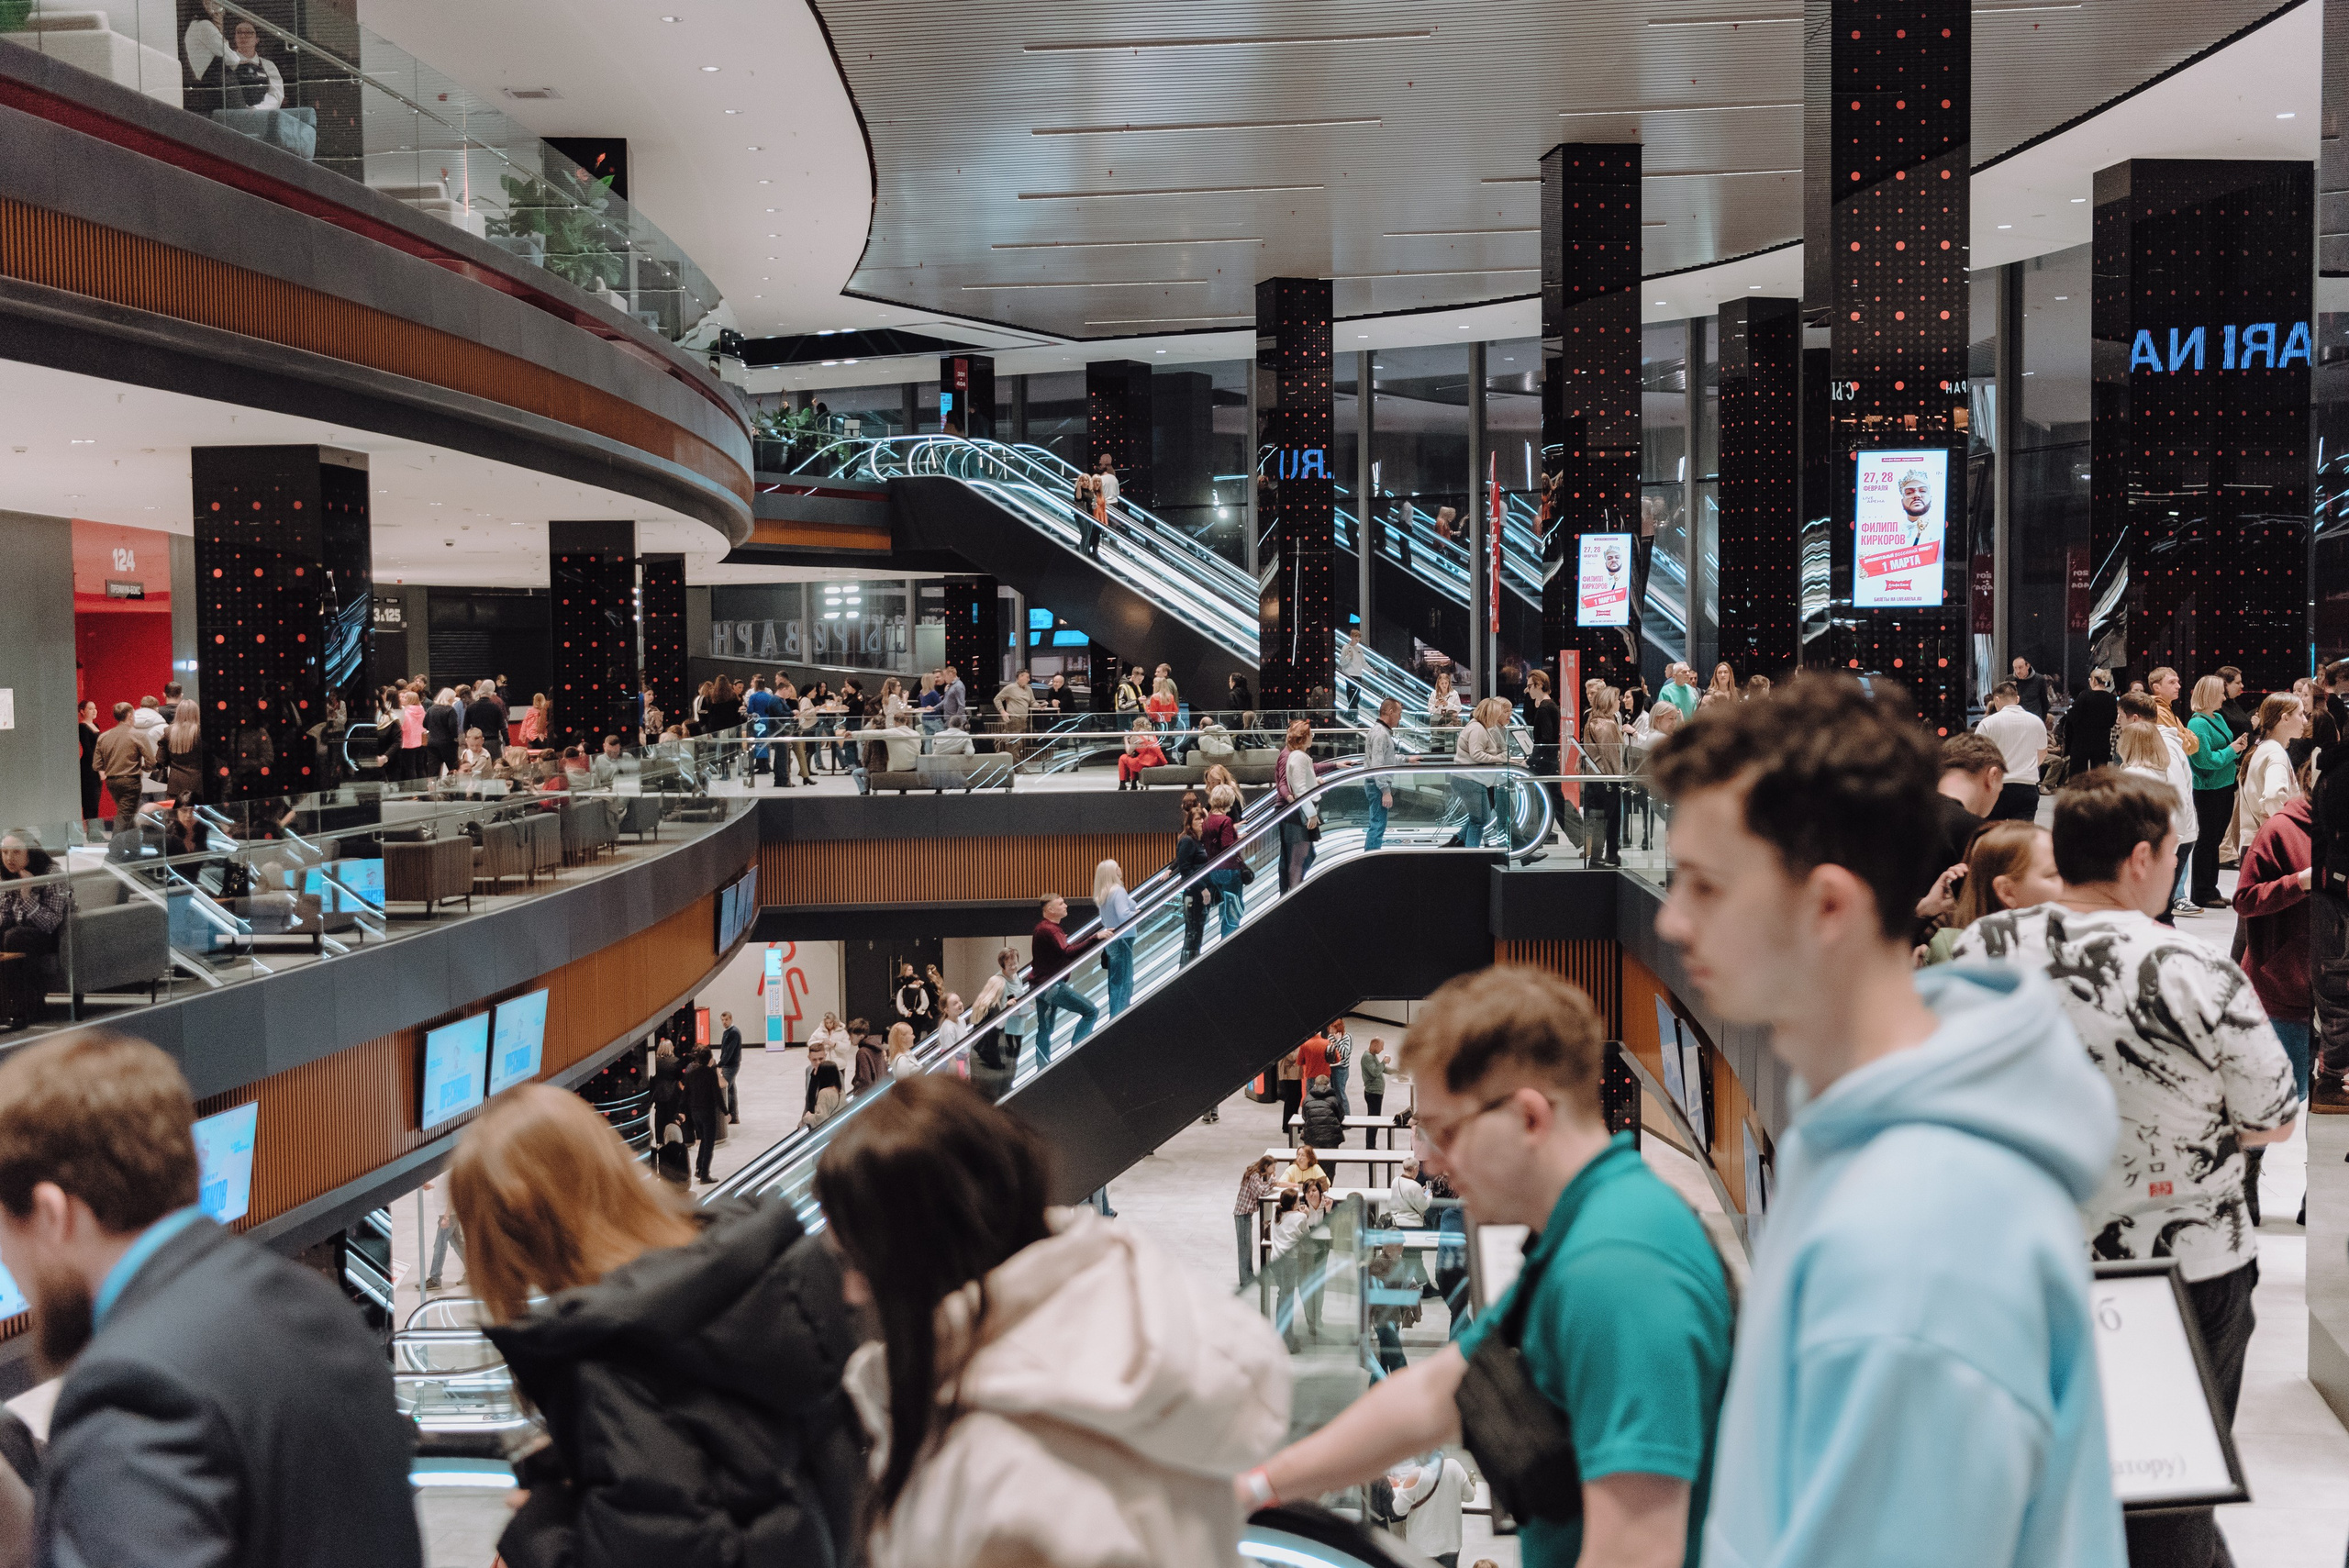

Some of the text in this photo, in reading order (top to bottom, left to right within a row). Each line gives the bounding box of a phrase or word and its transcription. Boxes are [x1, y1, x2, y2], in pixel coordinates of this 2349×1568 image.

[1864, 472, 1893, 484] 27, 28
[1861, 521, 1898, 533] ФИЛИПП
[1860, 534, 1906, 545] КИРКОРОВ
[112, 548, 136, 572] 124
[1889, 555, 1921, 571] МАРТА
